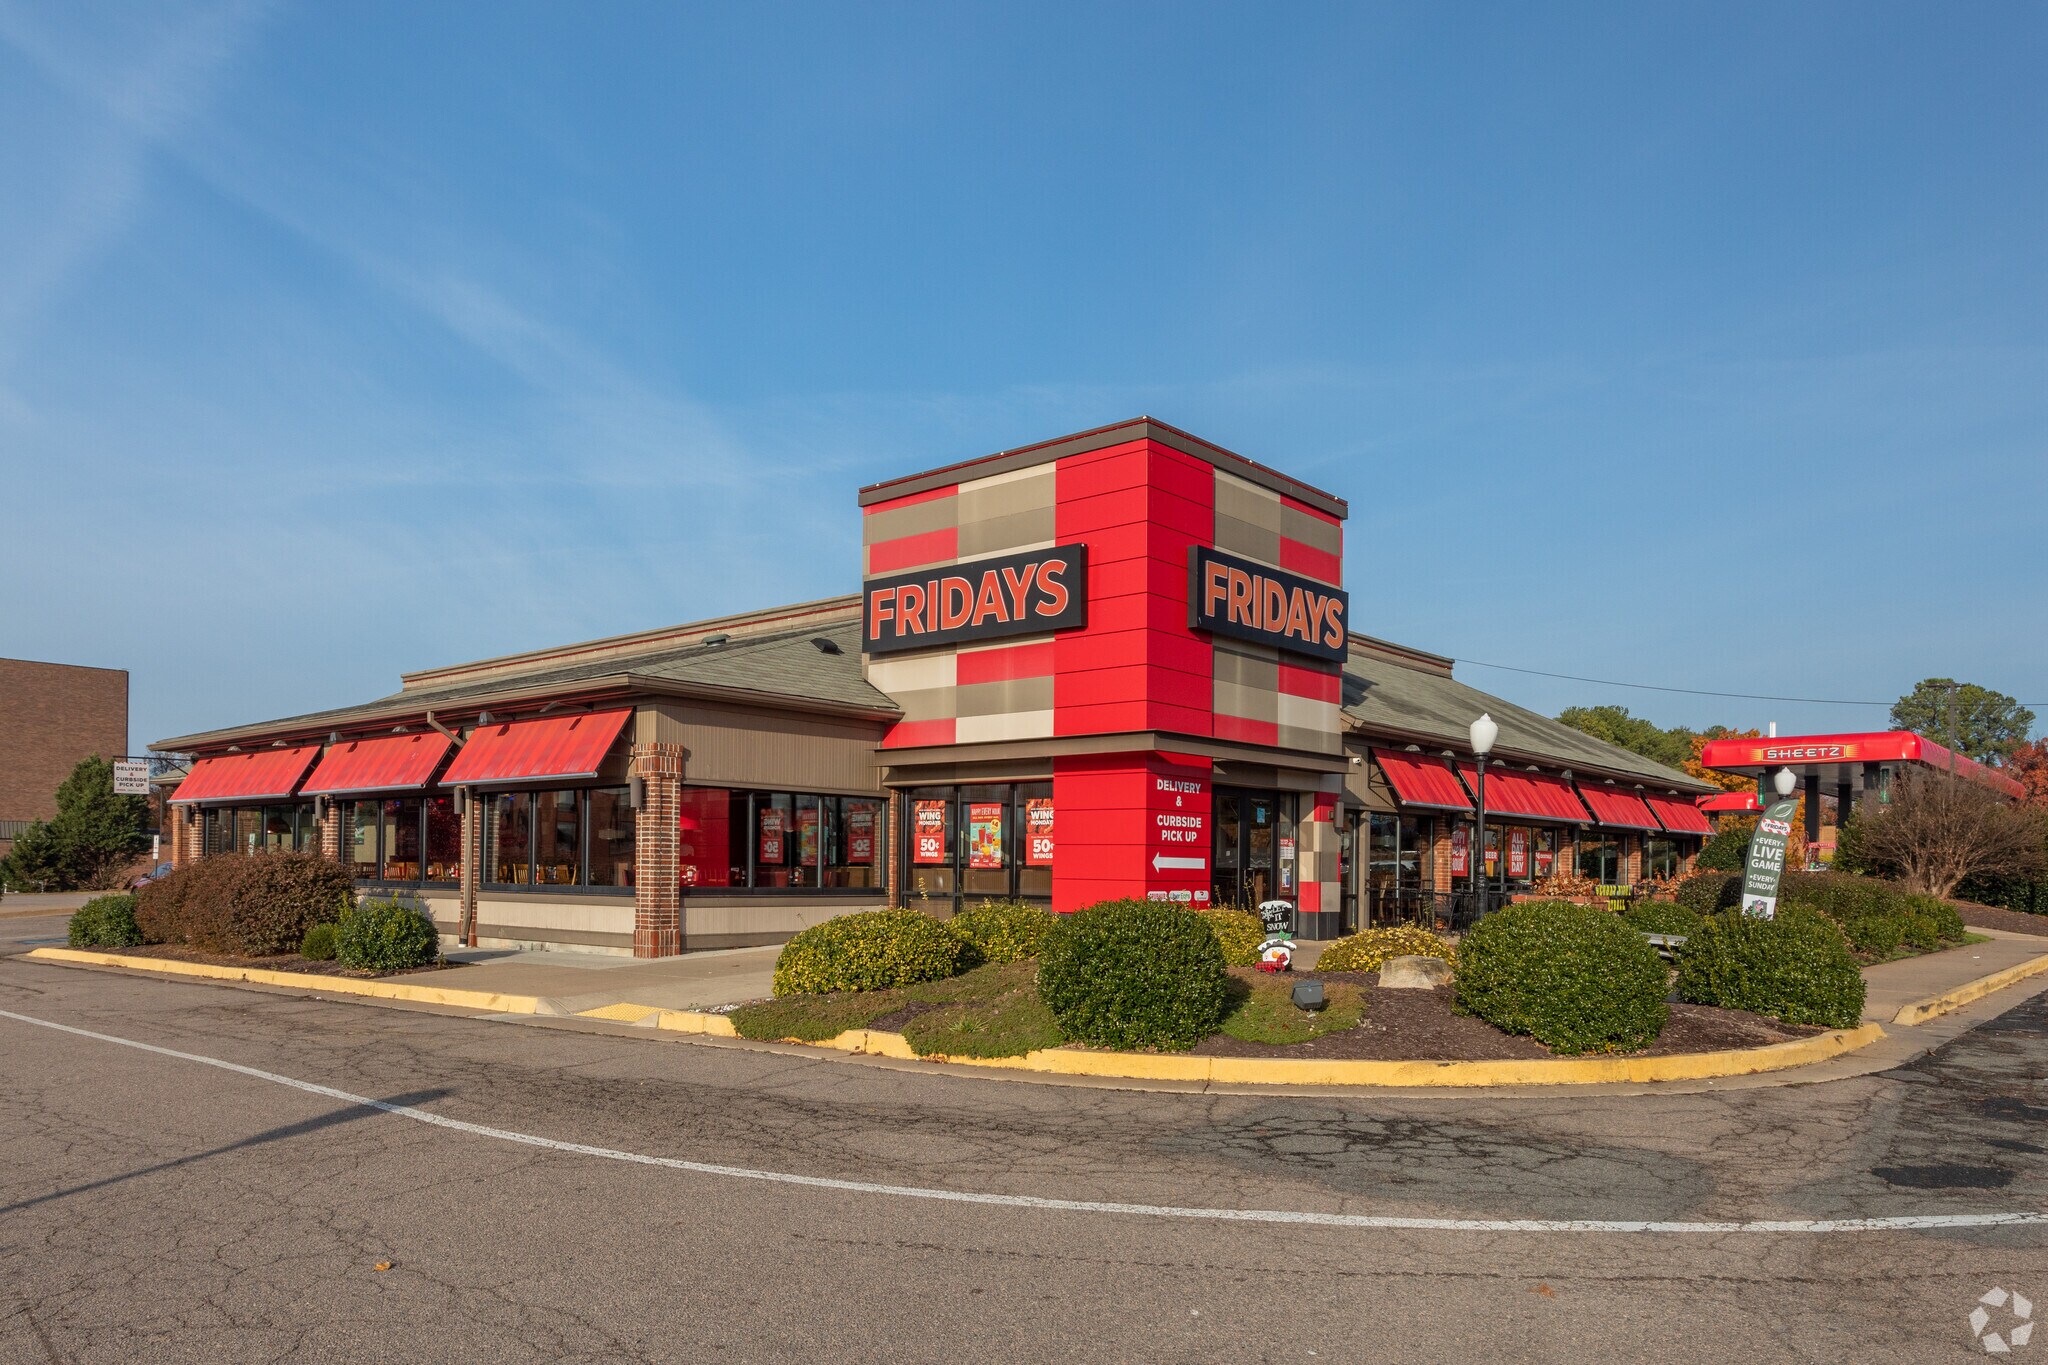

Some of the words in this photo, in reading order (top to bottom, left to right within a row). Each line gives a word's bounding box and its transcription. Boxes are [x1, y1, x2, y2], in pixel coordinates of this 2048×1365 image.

[869, 559, 1069, 640] FRIDAYS
[1204, 560, 1344, 648] FRIDAYS
[1767, 747, 1840, 759] SHEETZ
[1157, 779, 1201, 794] DELIVERY
[1176, 796, 1182, 807] &
[919, 812, 941, 820] WING
[1157, 815, 1202, 828] CURBSIDE
[1162, 830, 1183, 842] PICK
[1185, 831, 1197, 842] UP
[1512, 833, 1524, 843] ALL
[1759, 837, 1781, 846] EVERY
[920, 839, 940, 851] 50¢
[1512, 844, 1524, 854] DAY
[1753, 845, 1783, 861] LIVE
[1512, 862, 1524, 872] DAY
[1751, 858, 1781, 872] GAME
[1753, 874, 1774, 883] EVERY
[1748, 881, 1775, 891] SUNDAY
[1274, 913, 1283, 921] IT
[1266, 922, 1289, 931] SNOW
